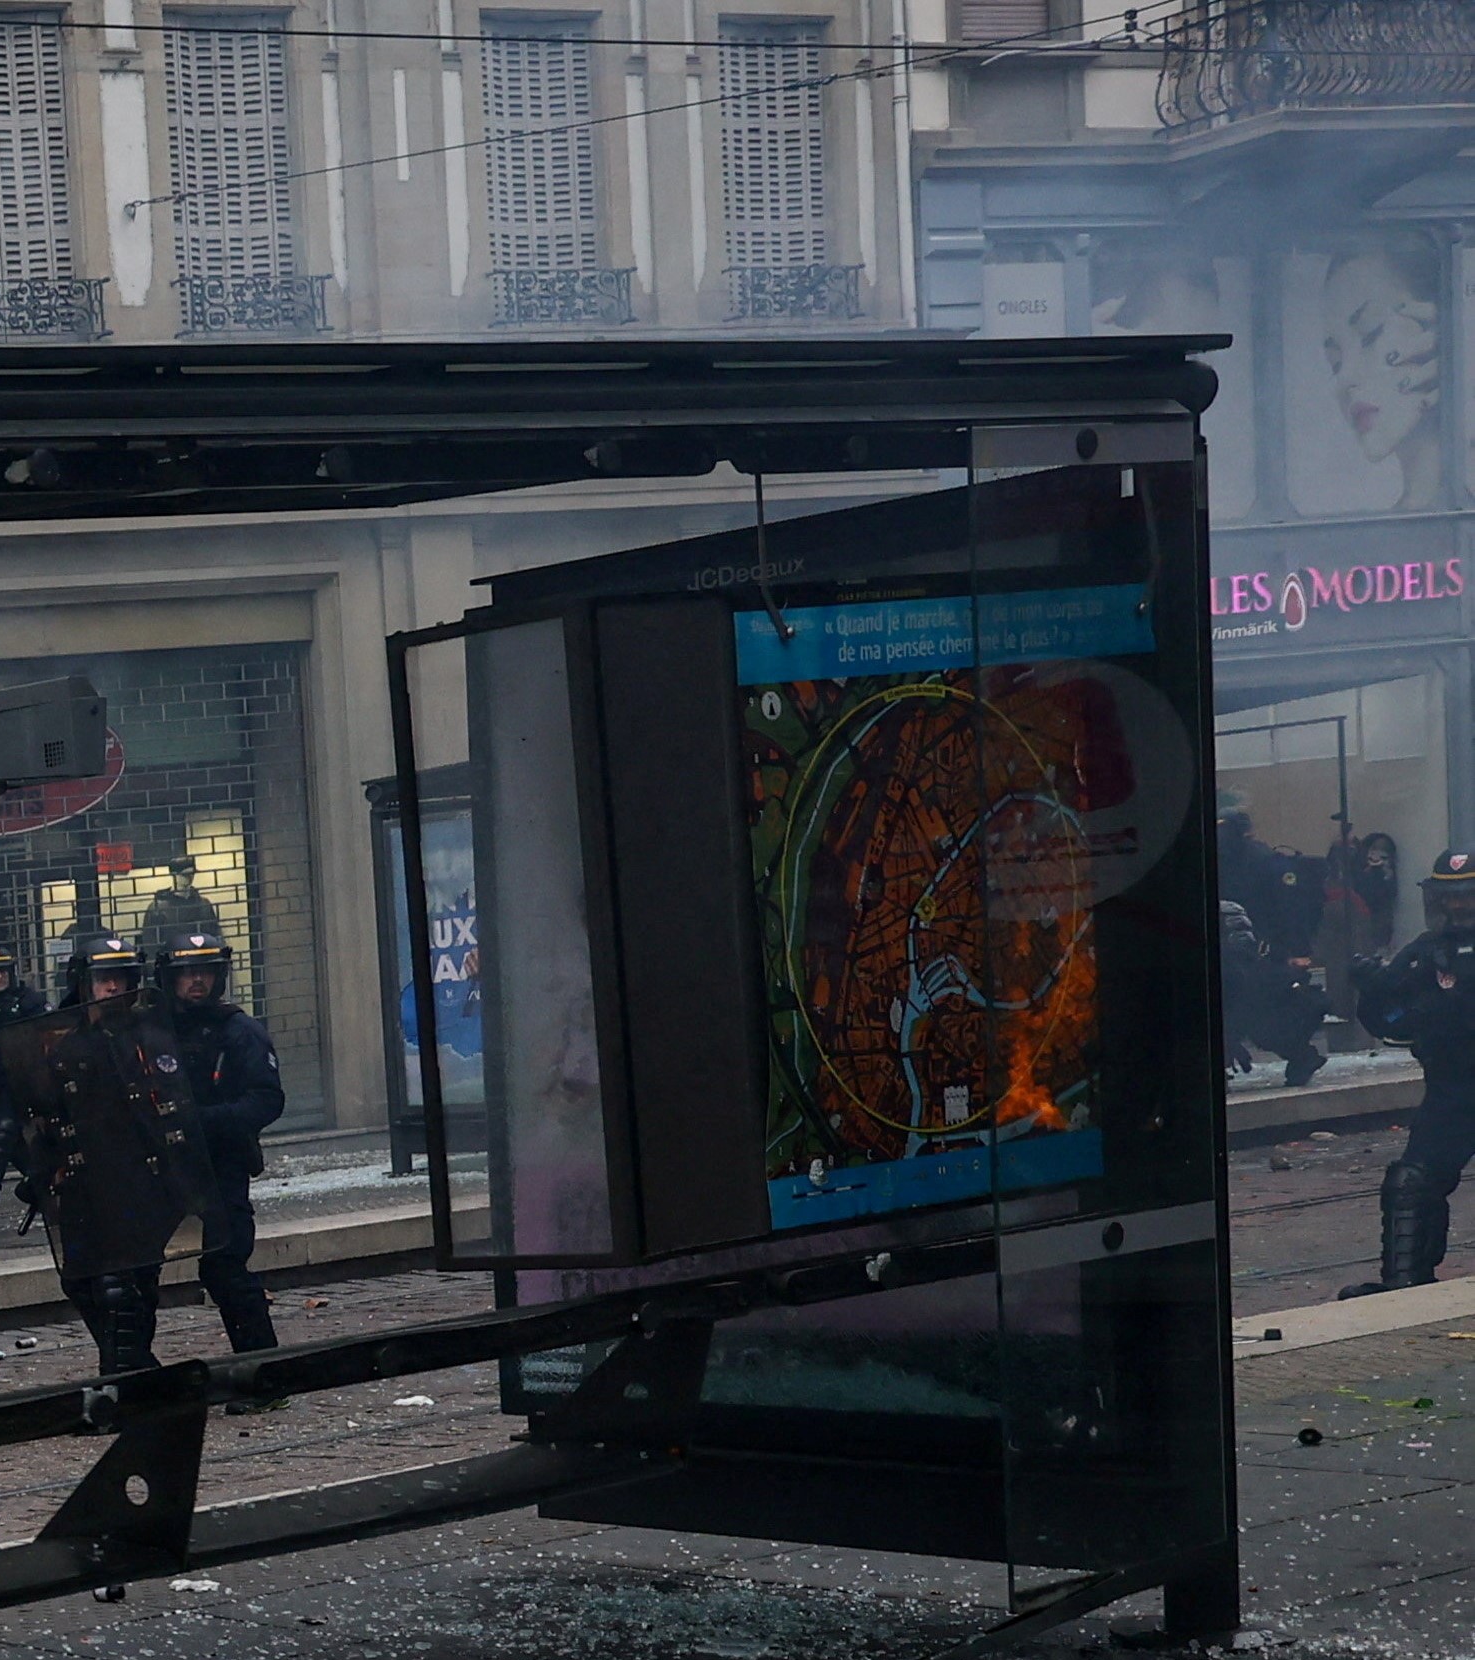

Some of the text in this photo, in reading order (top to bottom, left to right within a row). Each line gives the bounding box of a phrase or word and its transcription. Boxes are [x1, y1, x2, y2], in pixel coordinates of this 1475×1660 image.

[998, 299, 1048, 315] ONGLES
[687, 558, 805, 591] JCDecaux
[1209, 557, 1464, 616] LES MODELS
[835, 613, 883, 636] Quand
[887, 609, 900, 637] je
[838, 641, 856, 663] de
[860, 642, 881, 661] ma
[886, 634, 936, 663] pensée
